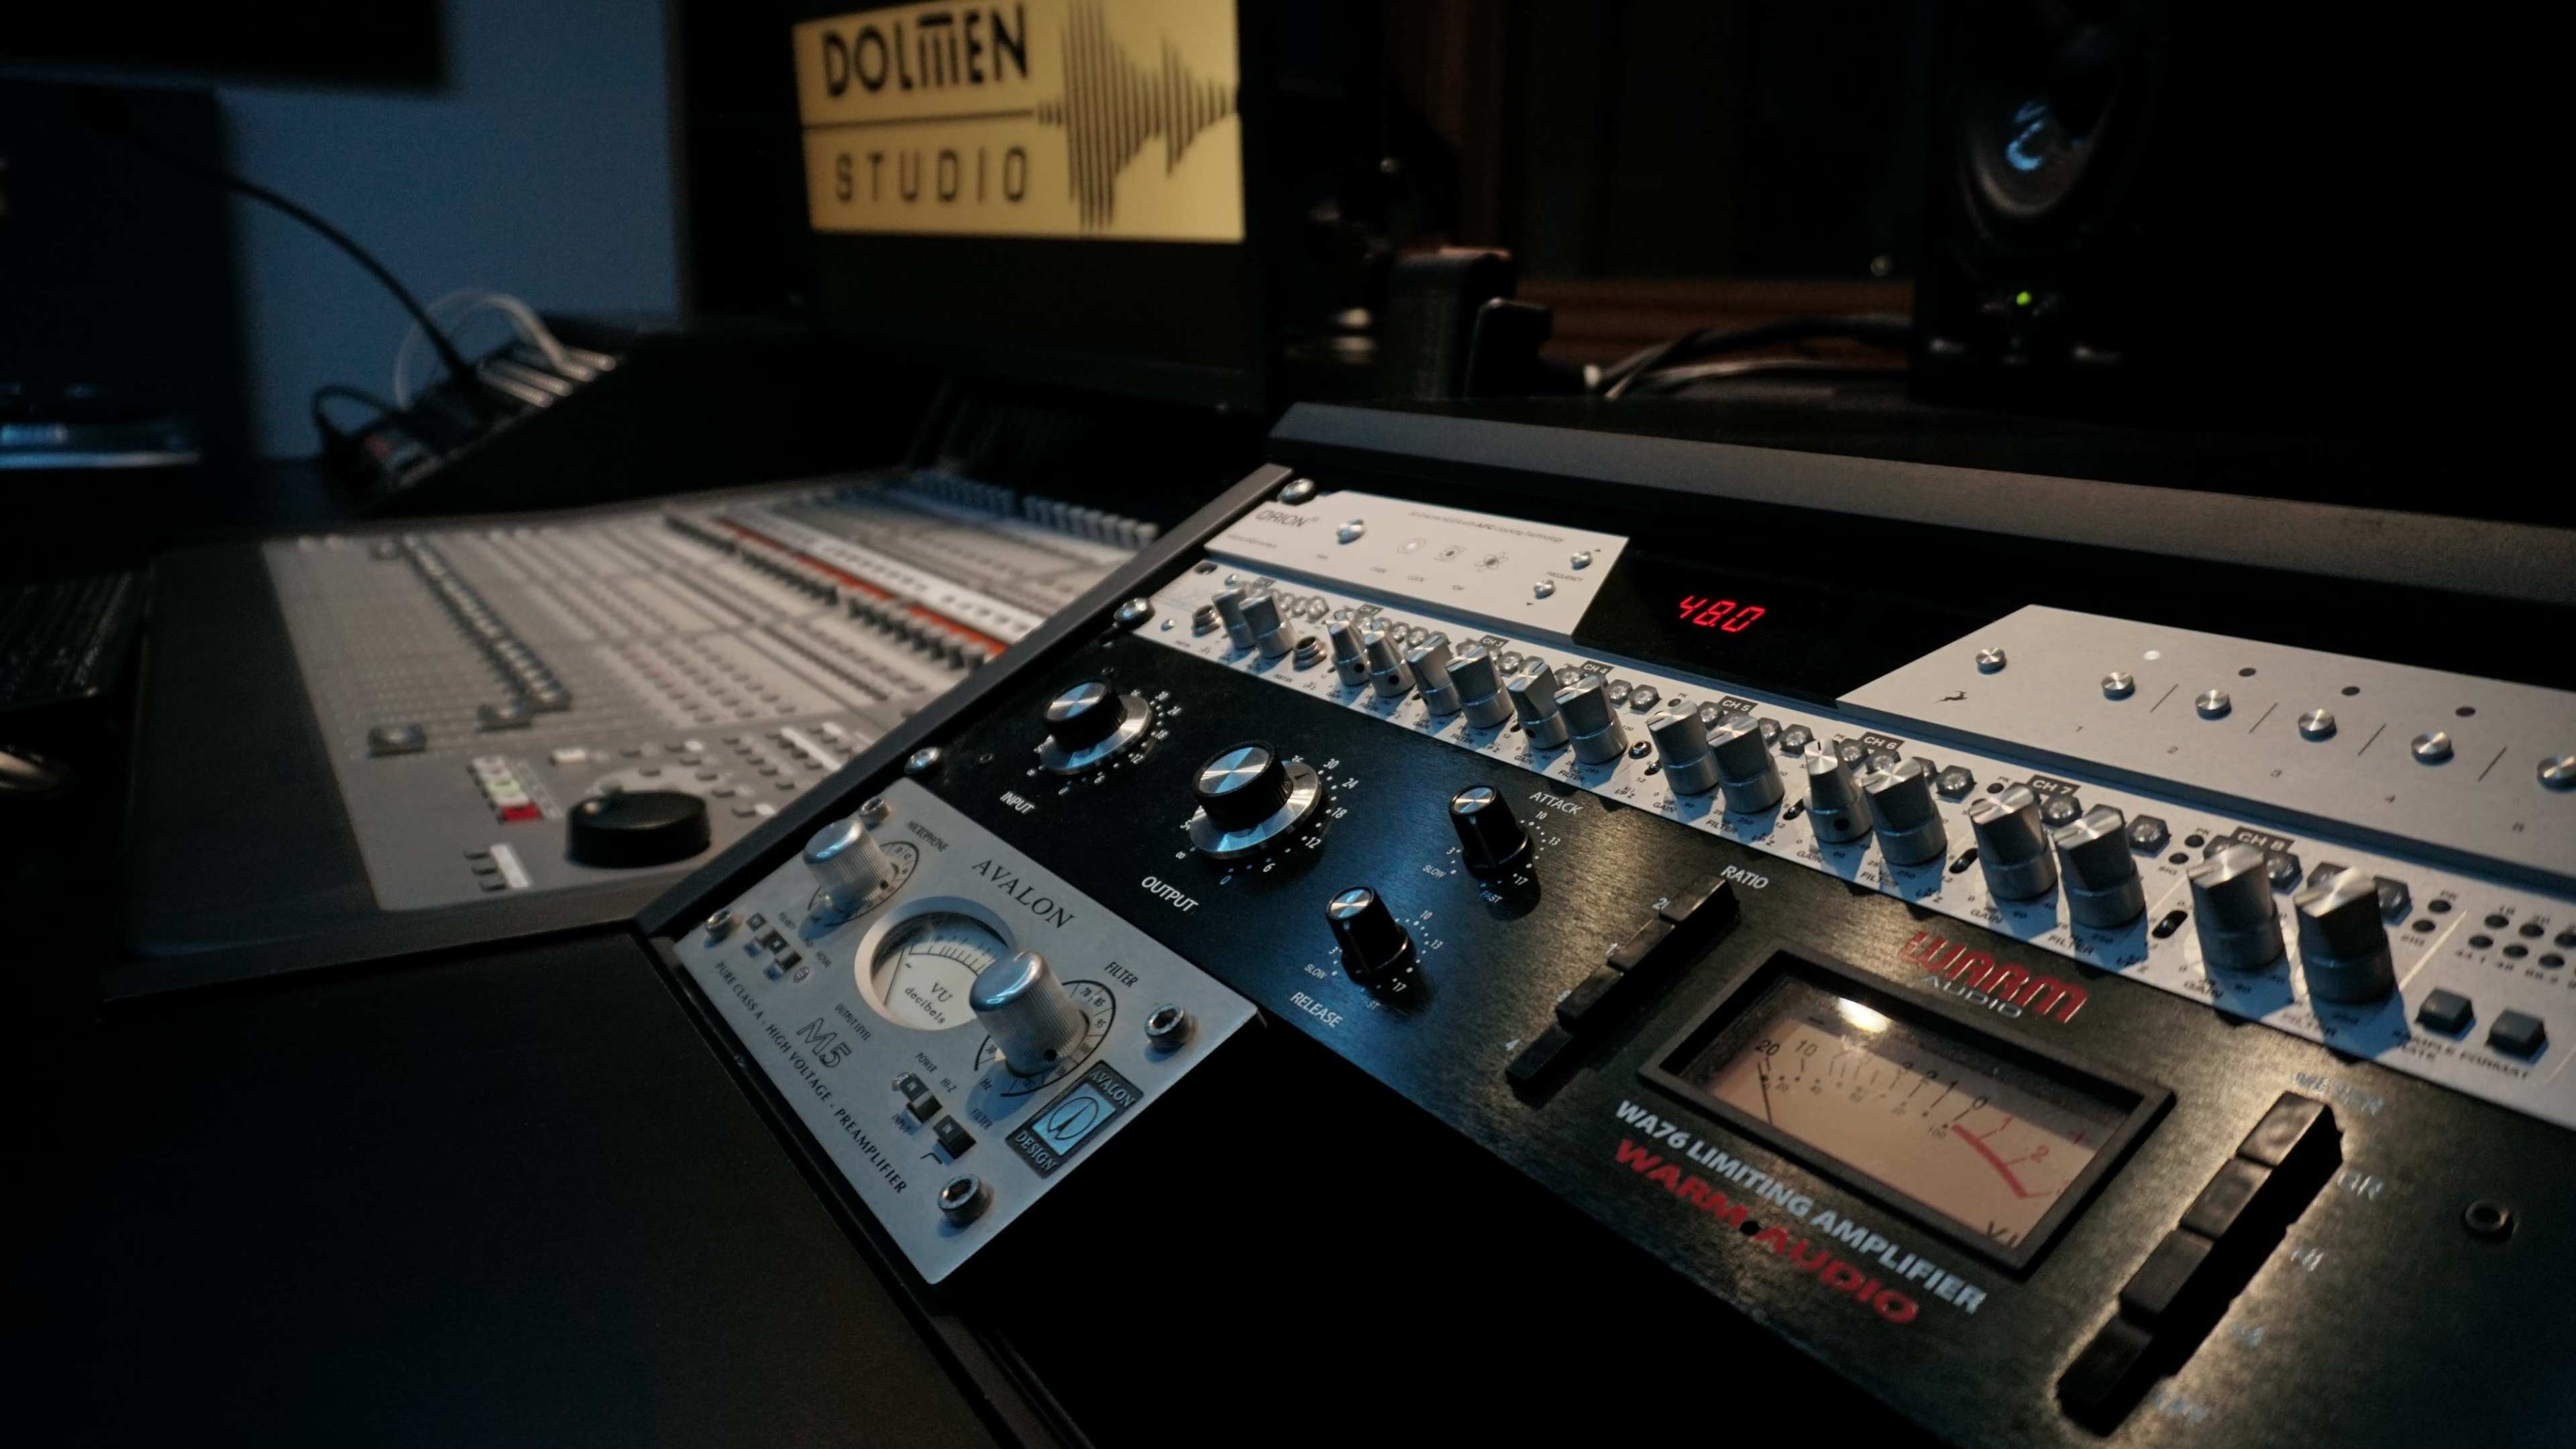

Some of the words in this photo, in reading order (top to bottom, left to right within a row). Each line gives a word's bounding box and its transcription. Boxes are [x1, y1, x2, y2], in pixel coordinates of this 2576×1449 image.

[822, 4, 1028, 97] DOLMEN
[835, 146, 1028, 202] STUDIO
[1255, 510, 1309, 527] ORION
[1481, 637, 1494, 645] CH
[1582, 663, 1598, 672] CH
[1722, 698, 1739, 708] CH
[1741, 703, 1752, 712] 5
[1864, 735, 1884, 747] CH
[1886, 741, 1897, 750] 6
[1323, 758, 1340, 769] 30
[1514, 755, 1535, 765] GAIN
[1342, 777, 1359, 789] 24
[1558, 770, 1585, 782] FILTER
[2032, 779, 2057, 792] CH
[2060, 786, 2072, 795] 7
[1000, 790, 1036, 815] INPUT
[1529, 792, 1584, 816] ATTACK
[1653, 802, 1676, 813] GAIN
[1331, 807, 1348, 819] 18
[1535, 810, 1548, 820] 10
[1706, 819, 1737, 833] FILTER
[906, 821, 949, 852] MICROPHONE
[1305, 837, 1322, 849] 12
[1548, 837, 1561, 847] 13
[2237, 830, 2267, 845] CH
[1446, 847, 1456, 855] 3
[1796, 851, 1824, 863] GAIN
[1263, 863, 1275, 873] 6
[1422, 864, 1446, 879] SLOW
[1220, 875, 1232, 885] 0
[1514, 875, 1529, 886] 17
[1720, 865, 1770, 890] RATIO
[971, 859, 1075, 928] AVALON
[1140, 875, 1199, 912] OUTPUT
[1481, 890, 1503, 904] FAST
[1419, 910, 1433, 920] 10
[1970, 909, 2002, 924] GAIN
[1328, 946, 1338, 955] 3
[1430, 939, 1443, 950] 13
[1104, 961, 1139, 988] FILTER
[1304, 963, 1327, 979] SLOW
[1900, 930, 2088, 1024] WARM
[930, 982, 953, 1002] VU
[1392, 981, 1407, 993] 17
[1919, 975, 2023, 1018] AUDIO
[904, 987, 946, 1024] decibels
[1289, 991, 1343, 1028] RELEASE
[835, 1004, 857, 1028] OUTPUT
[855, 1023, 871, 1041] LEVEL
[797, 1018, 852, 1067] M5
[1756, 1039, 1780, 1057] 20
[1794, 1040, 1818, 1057] 10
[916, 1052, 937, 1073] POWER
[715, 961, 736, 985] PURE
[733, 983, 757, 1011] CLASS
[754, 1011, 763, 1020] A
[766, 1024, 792, 1053] HIGH
[792, 1051, 829, 1102] VOLTAGE
[834, 1108, 907, 1194] PREAMPLIFIER
[1090, 1069, 1136, 1108] AVALON
[1972, 1095, 1988, 1110] 0
[1015, 1129, 1059, 1173] DESIGN
[2030, 1144, 2051, 1163] 2
[1615, 1099, 1690, 1149] WA76
[1686, 1140, 1814, 1217] LIMITING
[1810, 1209, 1987, 1315] AMPLIFIER
[1614, 1137, 1748, 1228] WARM
[1755, 1226, 1920, 1324] AUDIO
